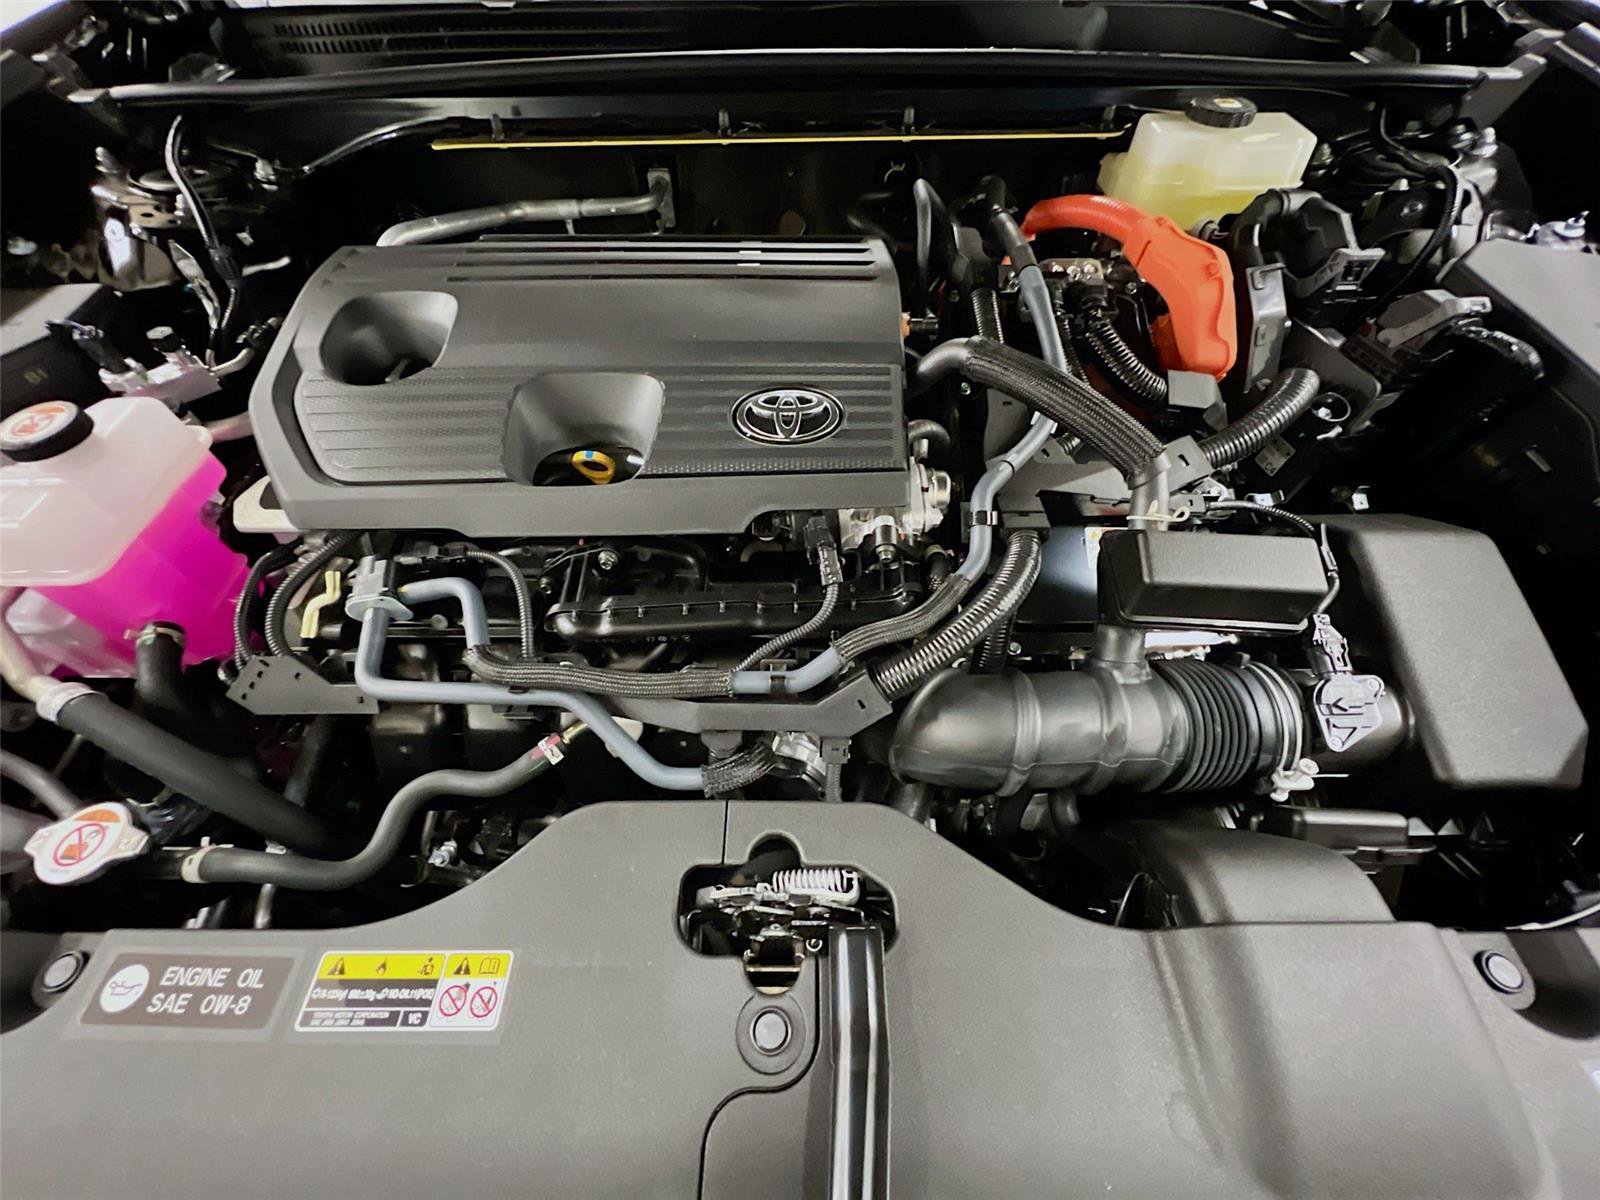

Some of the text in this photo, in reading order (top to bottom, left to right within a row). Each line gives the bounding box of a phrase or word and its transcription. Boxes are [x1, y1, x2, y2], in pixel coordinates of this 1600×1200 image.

[160, 966, 264, 988] ENGINE OIL
[146, 993, 252, 1014] SAE 0W-8
